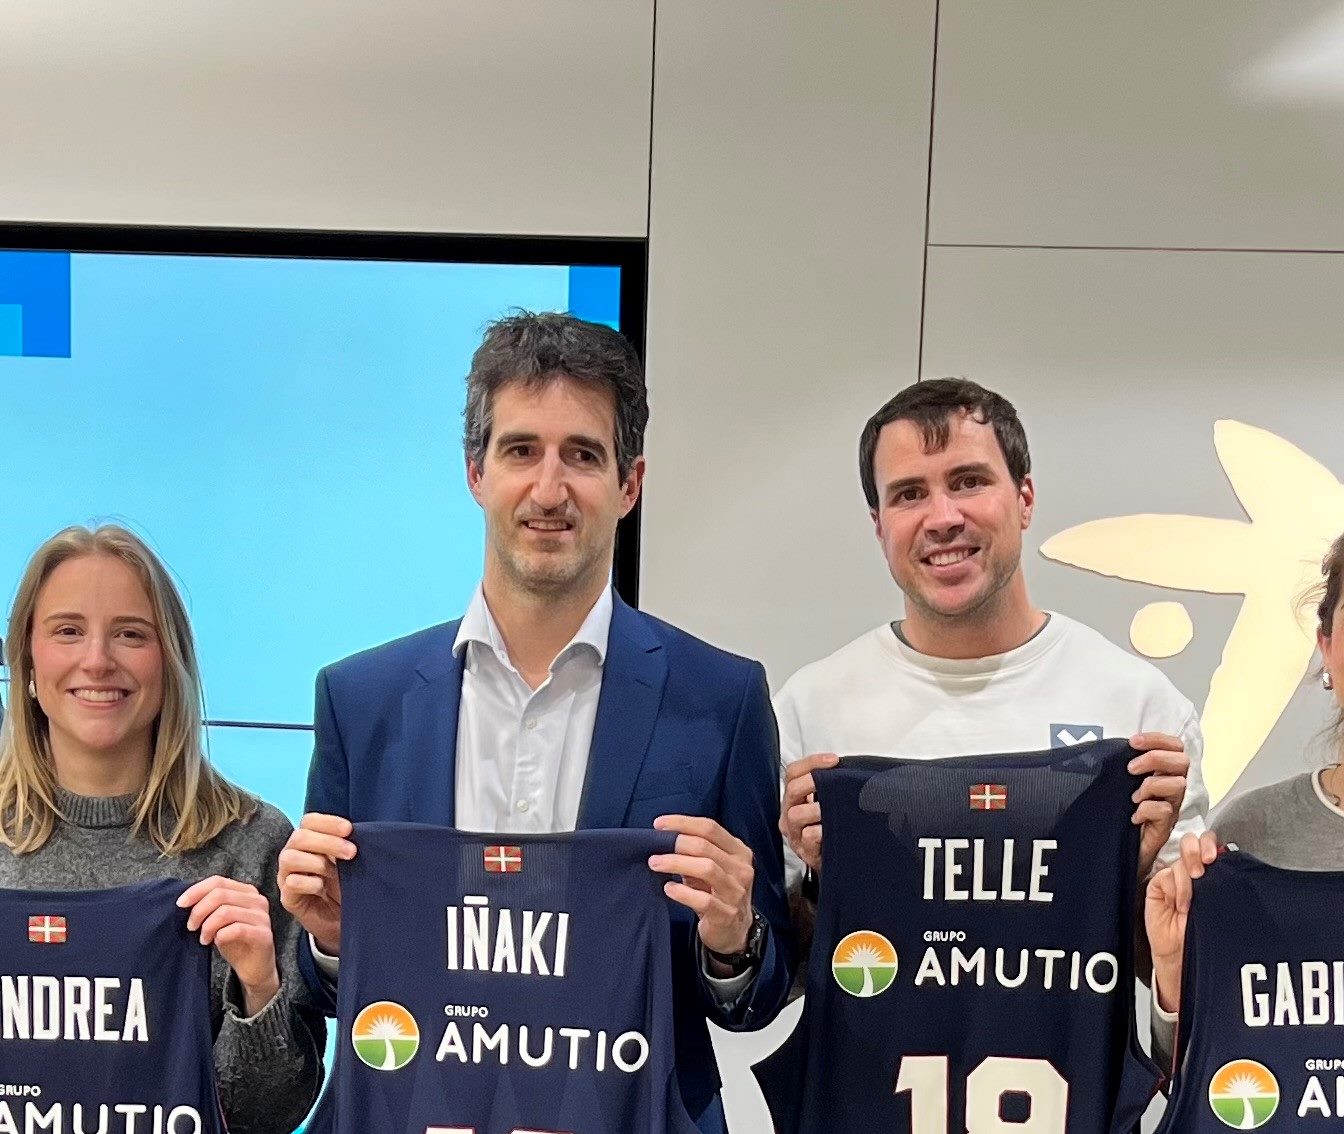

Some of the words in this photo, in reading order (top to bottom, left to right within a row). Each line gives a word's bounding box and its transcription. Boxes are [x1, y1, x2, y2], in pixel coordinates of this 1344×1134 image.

[917, 837, 1058, 902] TELLE
[446, 895, 570, 977] IÑAKI
[923, 930, 966, 942] GRUPO
[914, 946, 1118, 994] AMUTIO
[444, 1004, 489, 1018] GRUPO
[435, 1022, 650, 1073] AMUTIO
